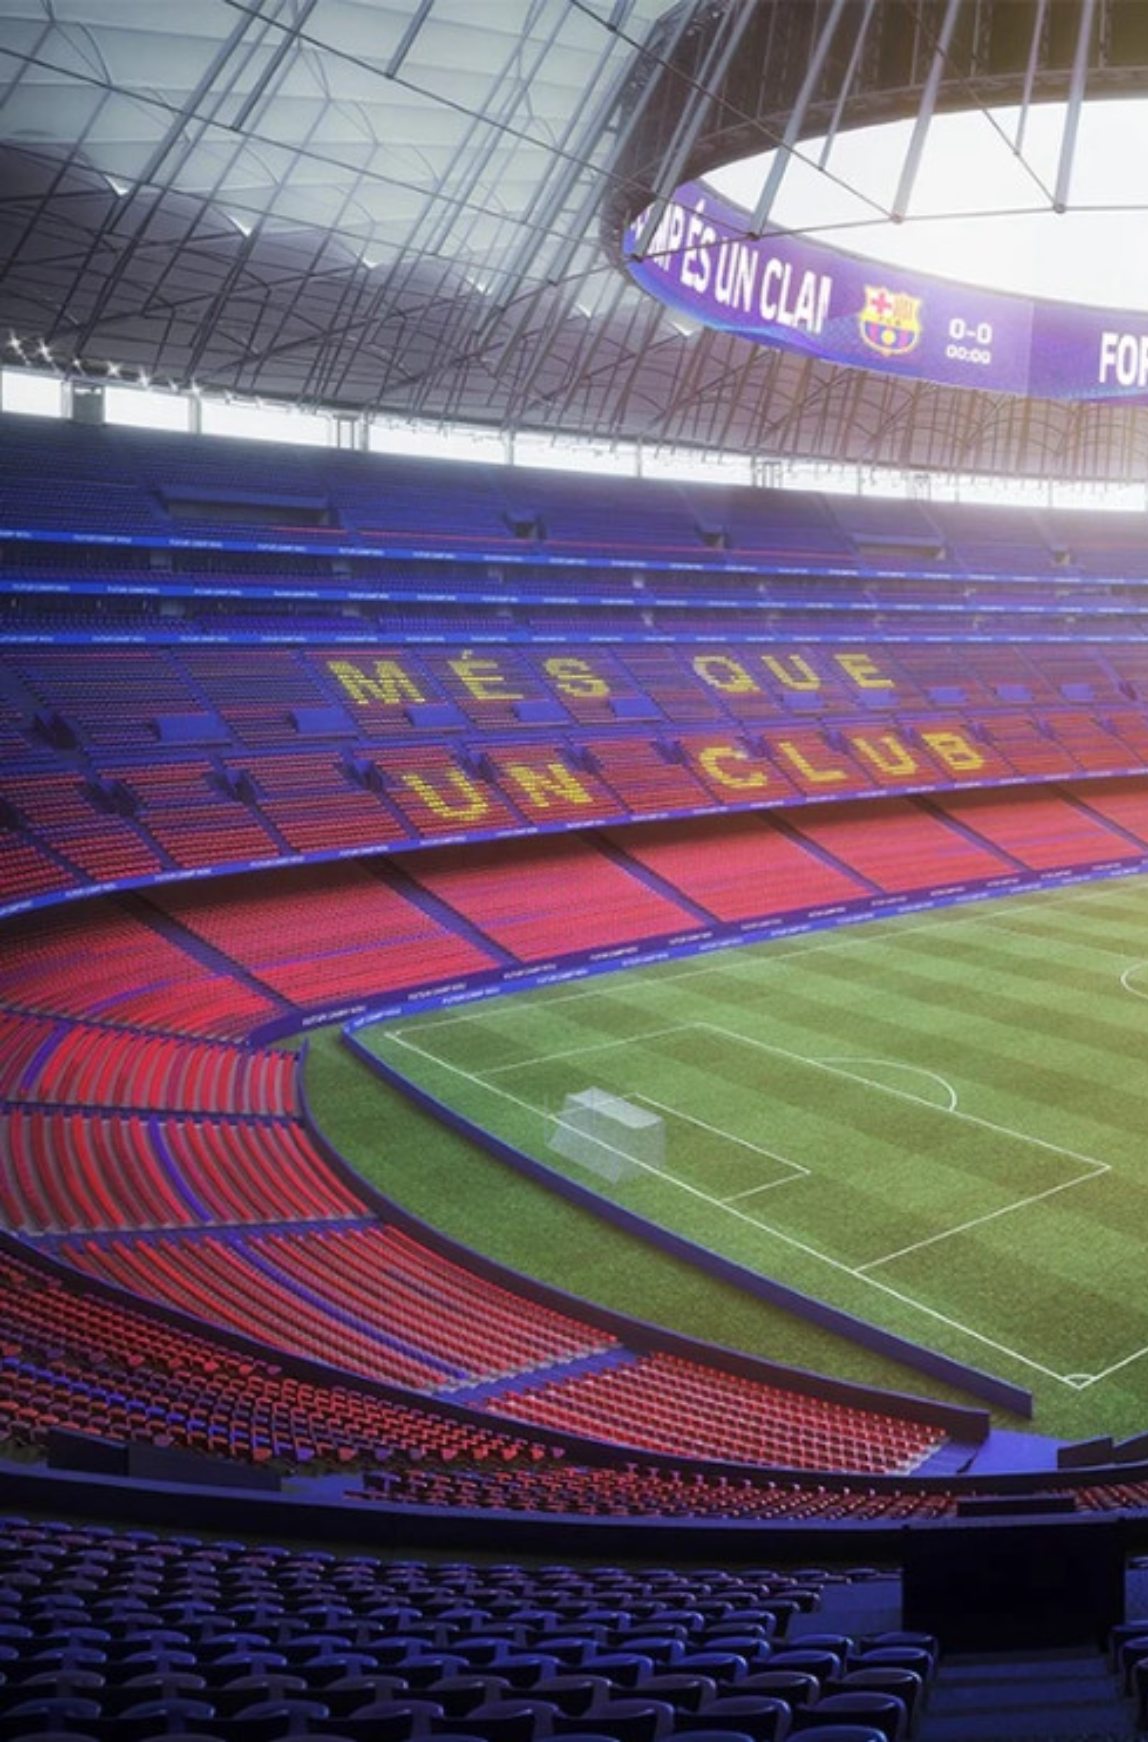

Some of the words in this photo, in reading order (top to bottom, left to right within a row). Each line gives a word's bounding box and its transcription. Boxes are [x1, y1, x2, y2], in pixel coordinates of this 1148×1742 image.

[681, 199, 716, 294] ÉS
[715, 236, 759, 313] UN
[946, 344, 991, 365] 00:00
[949, 318, 993, 344] 0-0
[327, 649, 610, 704] MÉS
[692, 653, 896, 692] QUE
[402, 763, 593, 820] UN
[700, 732, 984, 788] CLUB
